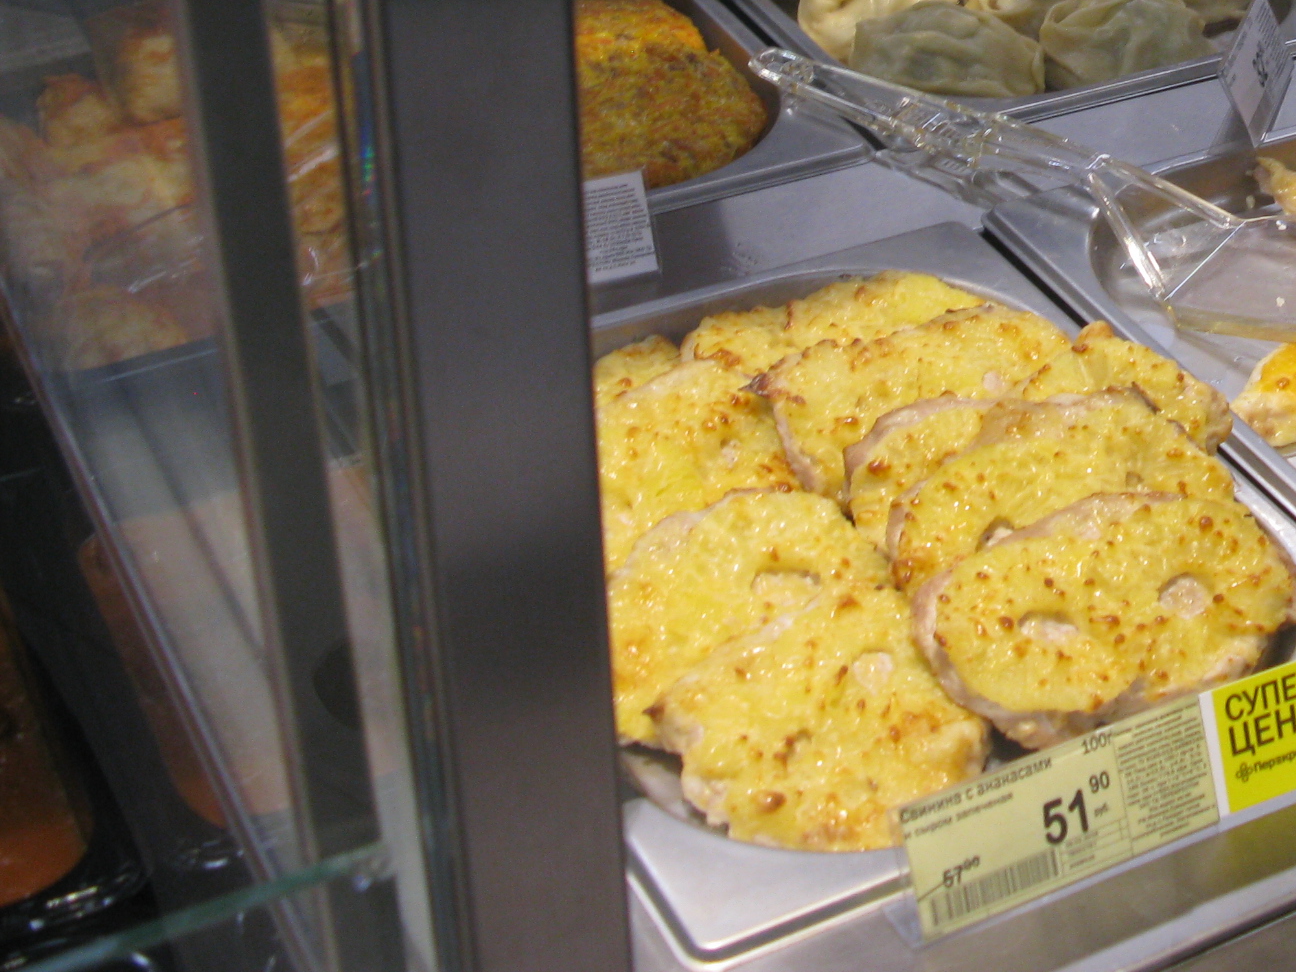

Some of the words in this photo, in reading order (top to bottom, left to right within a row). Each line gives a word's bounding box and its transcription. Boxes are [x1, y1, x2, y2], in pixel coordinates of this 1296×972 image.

[900, 792, 962, 823] Свинина
[965, 790, 975, 801] с
[977, 757, 1053, 796] ананасами
[1081, 732, 1113, 755] 100г
[1042, 788, 1089, 844] 51
[1089, 771, 1111, 794] 90
